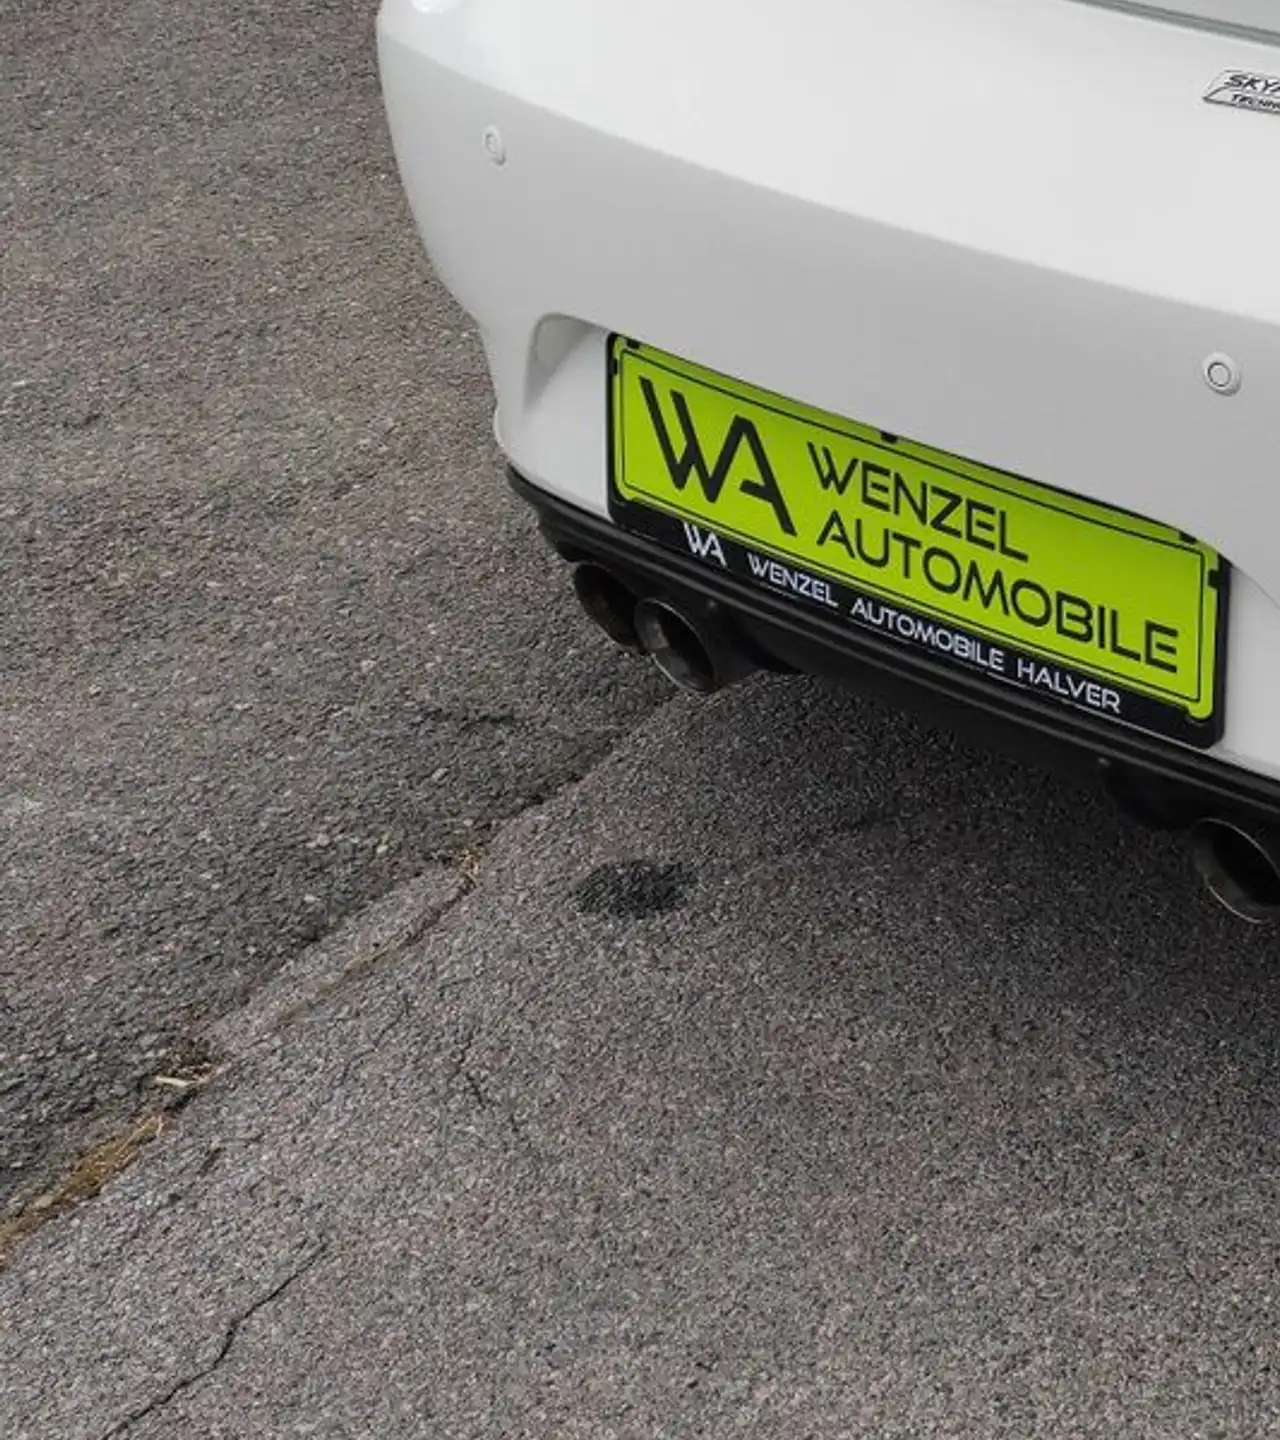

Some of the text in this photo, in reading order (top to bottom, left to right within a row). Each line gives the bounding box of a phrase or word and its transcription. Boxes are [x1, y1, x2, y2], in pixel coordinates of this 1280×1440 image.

[639, 375, 798, 537] WA
[807, 440, 1029, 562] WENZEL
[683, 520, 1121, 714] WA WENZEL AUTOMOBILE HALVER
[816, 508, 1179, 673] AUTOMOBILE
